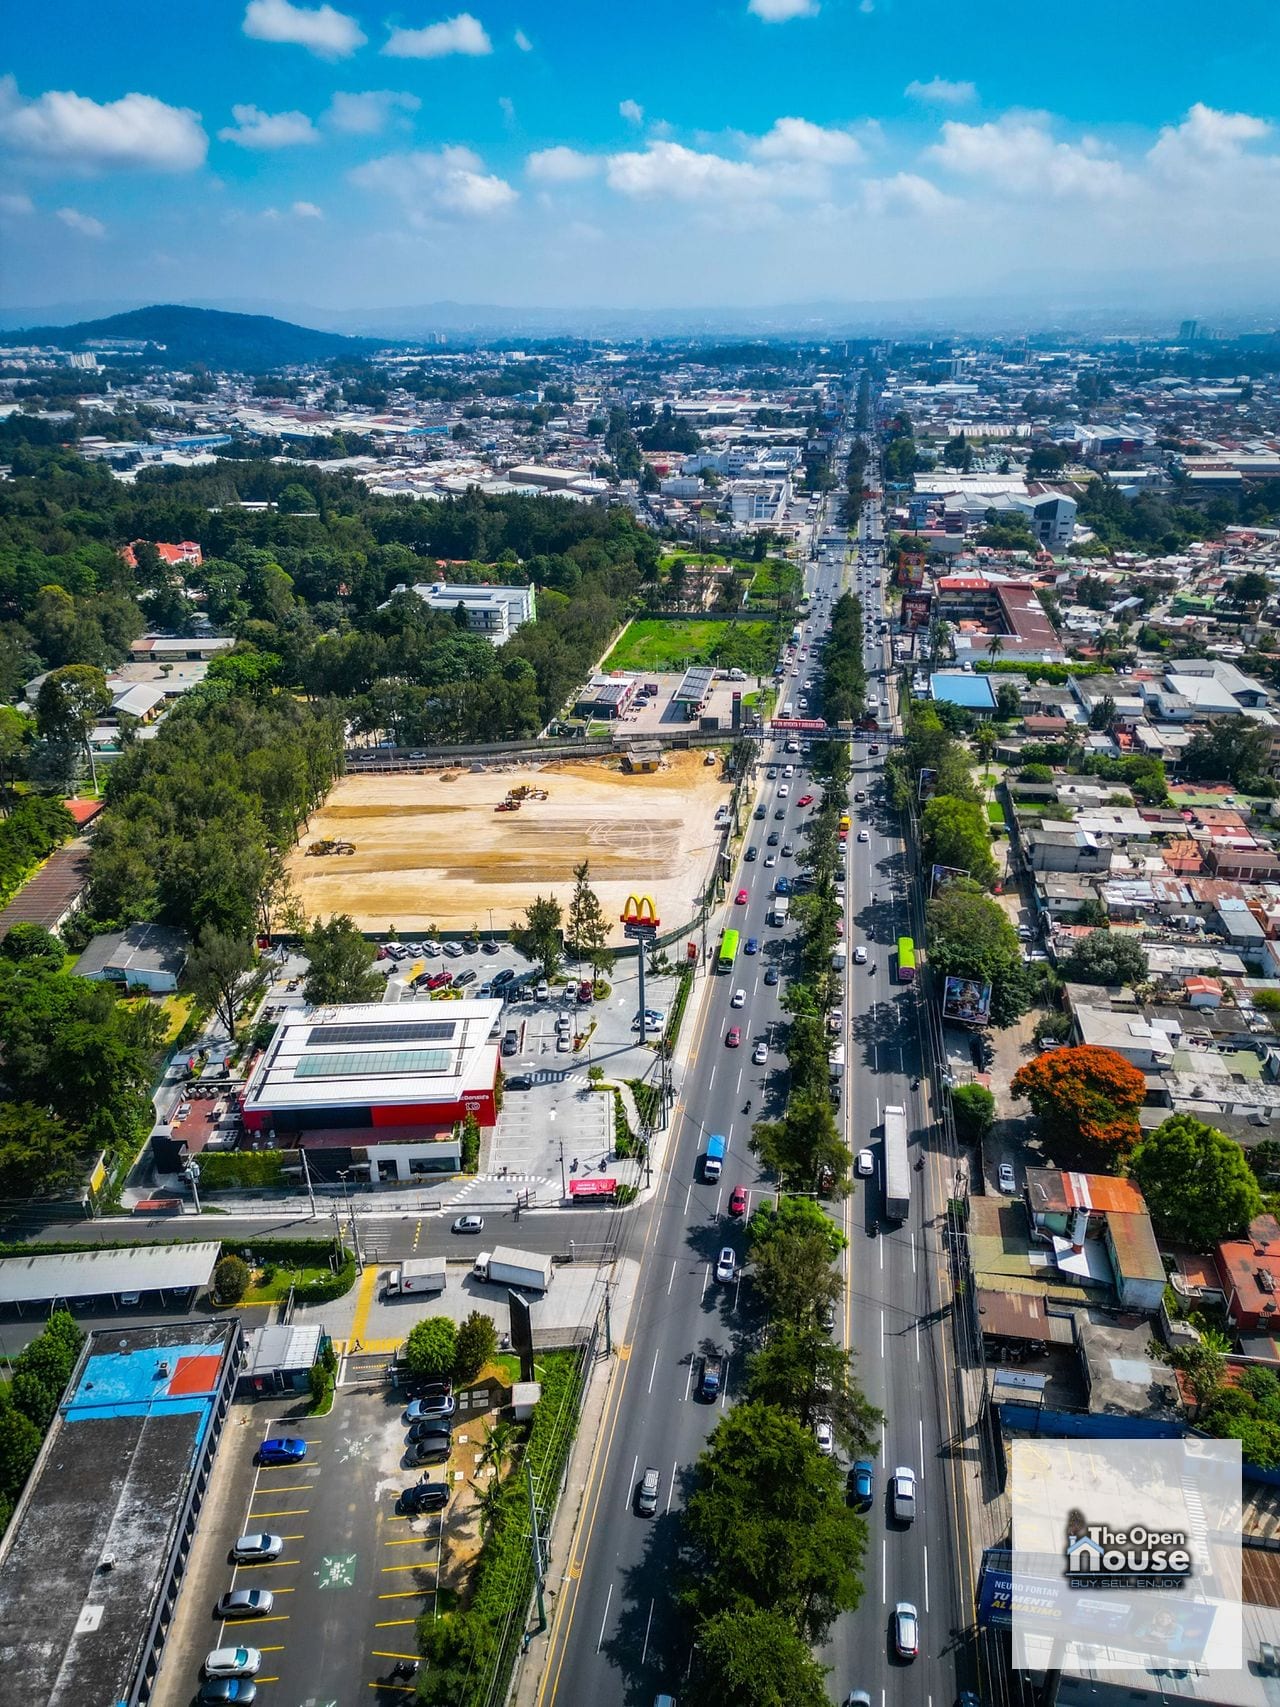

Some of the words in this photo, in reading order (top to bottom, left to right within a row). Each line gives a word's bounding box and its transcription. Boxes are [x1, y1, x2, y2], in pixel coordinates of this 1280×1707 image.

[994, 1581, 1023, 1592] NEURO
[991, 1600, 1006, 1609] AL
[993, 1592, 1010, 1601] TU
[1011, 1594, 1056, 1608] MENTE
